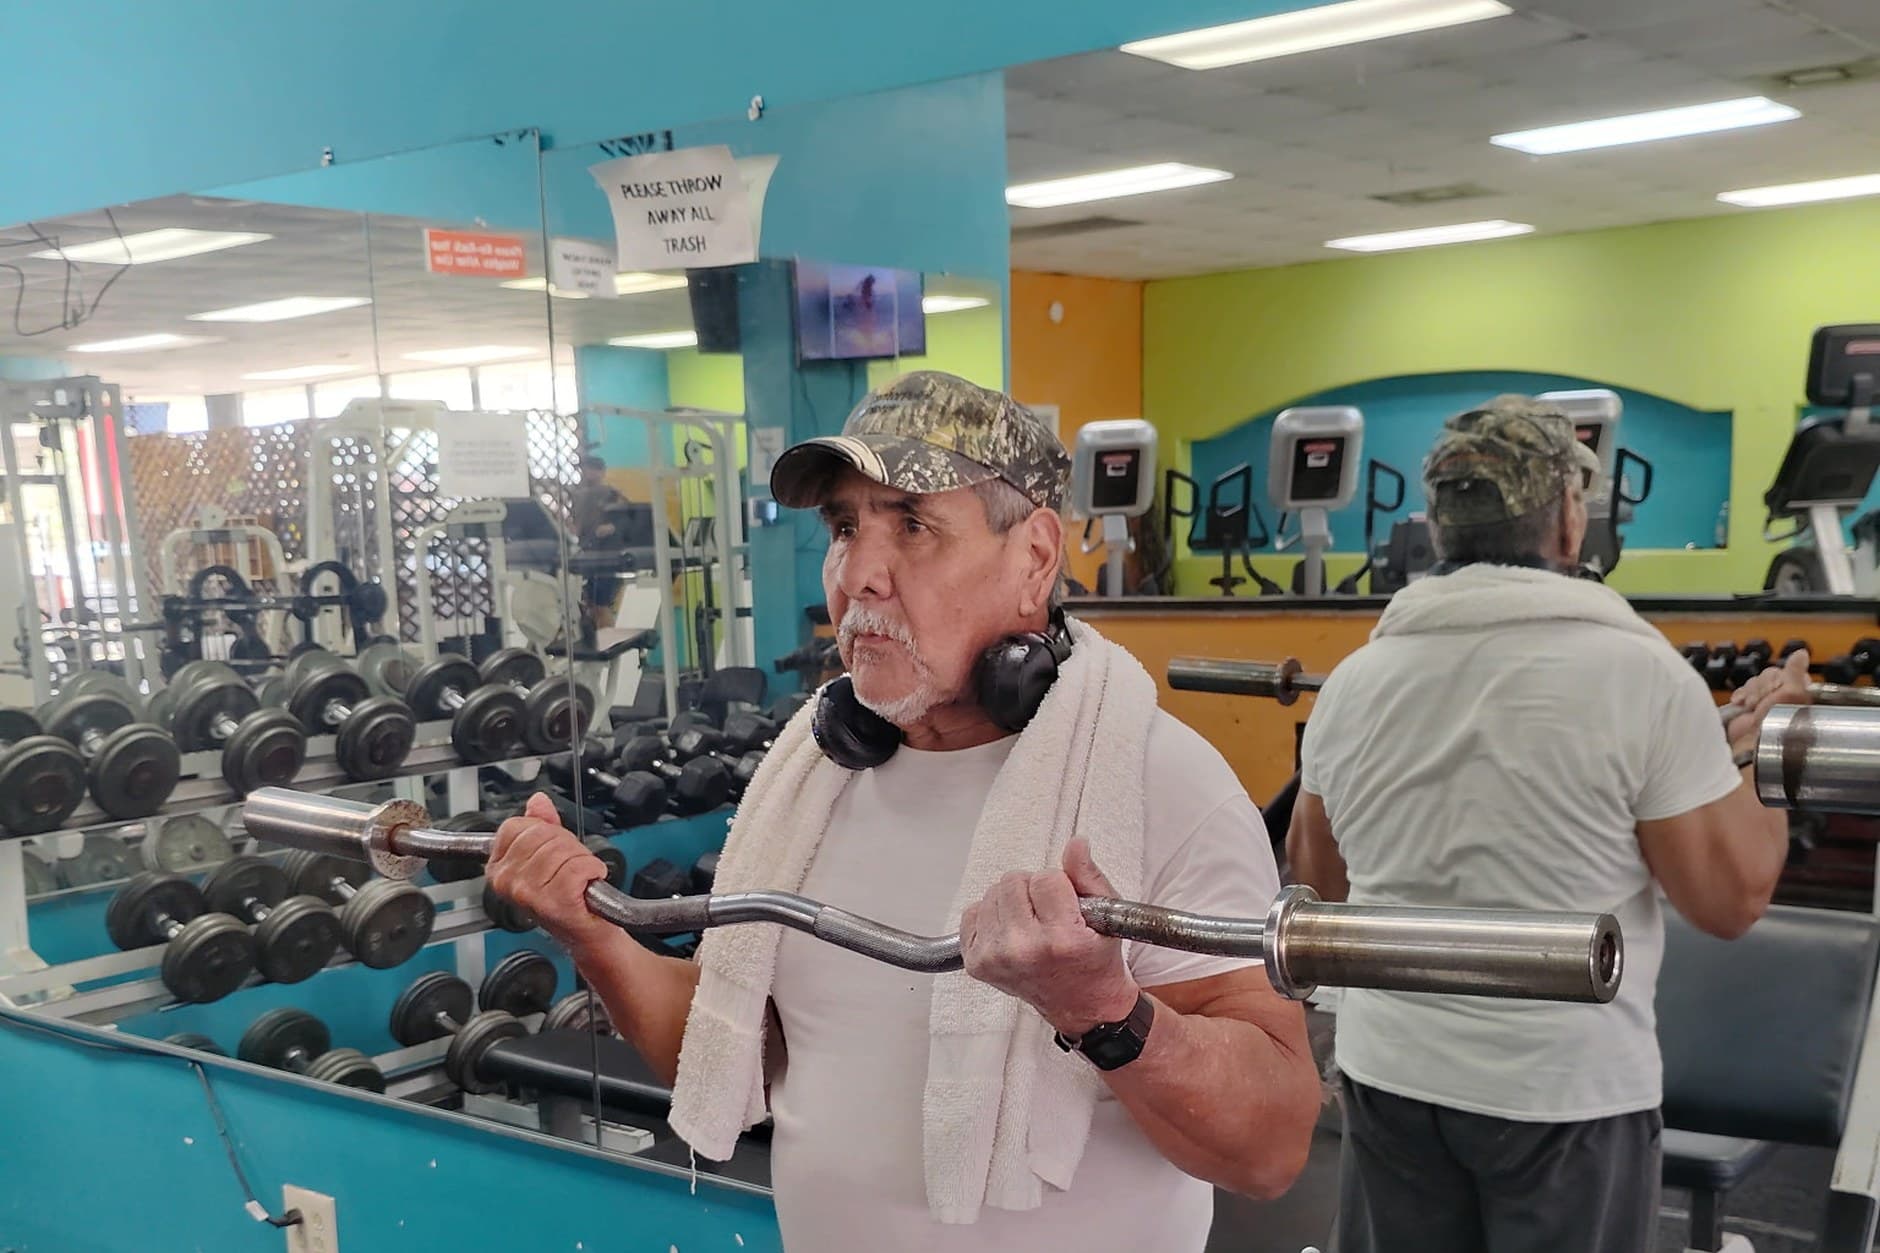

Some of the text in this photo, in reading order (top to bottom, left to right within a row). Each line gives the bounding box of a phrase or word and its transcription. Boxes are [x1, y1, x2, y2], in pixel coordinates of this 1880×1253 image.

[620, 174, 722, 199] PLEASE THROW
[648, 205, 716, 225] AWAY ALL
[664, 235, 706, 254] TRASH
